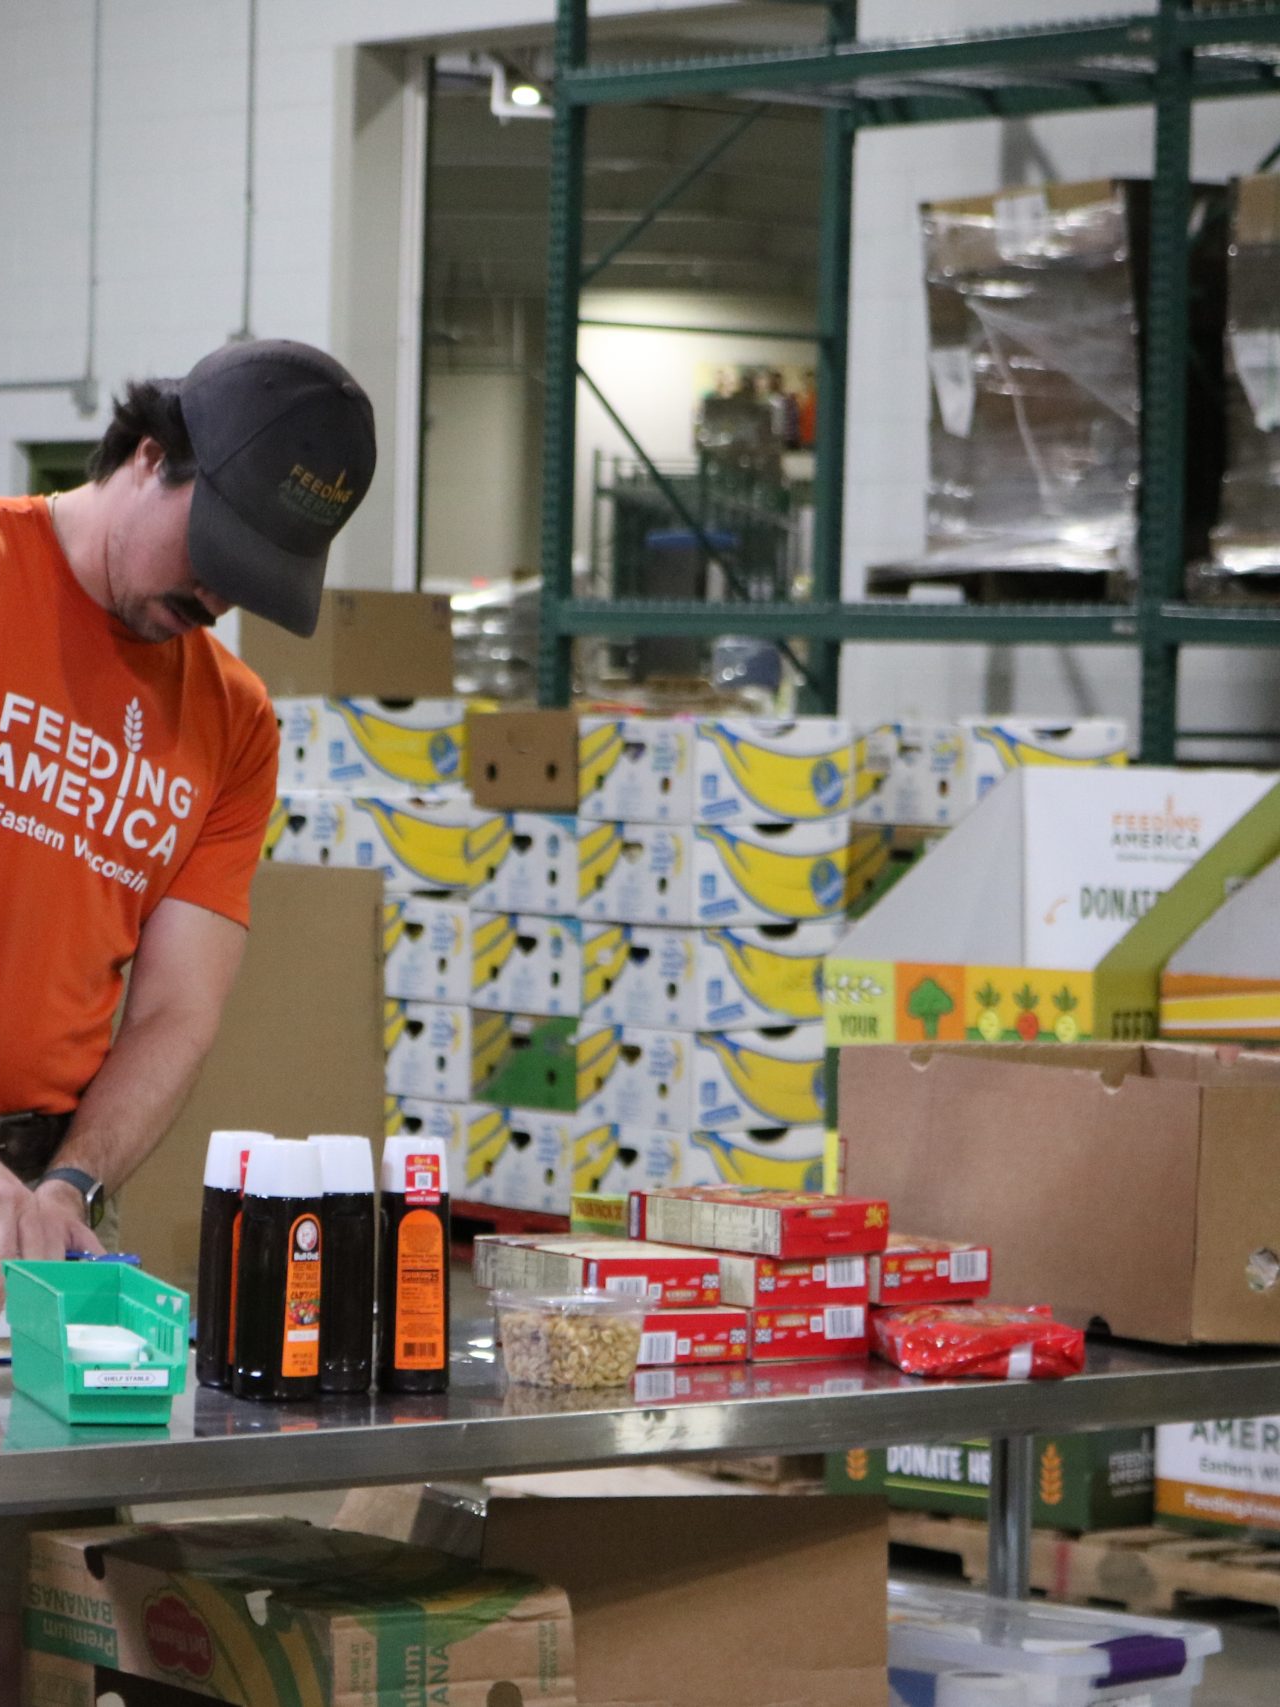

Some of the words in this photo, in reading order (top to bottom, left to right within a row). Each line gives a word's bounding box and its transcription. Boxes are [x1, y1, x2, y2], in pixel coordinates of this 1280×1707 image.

[289, 463, 353, 504] FEEDING
[1110, 812, 1201, 833] FEEDING
[1110, 831, 1200, 850] AMERICA
[1081, 887, 1162, 921] DONAT
[838, 1014, 878, 1038] YOUR
[886, 1444, 963, 1482] DONATE
[31, 1584, 114, 1625] BANANAS
[43, 1618, 115, 1658] Premium
